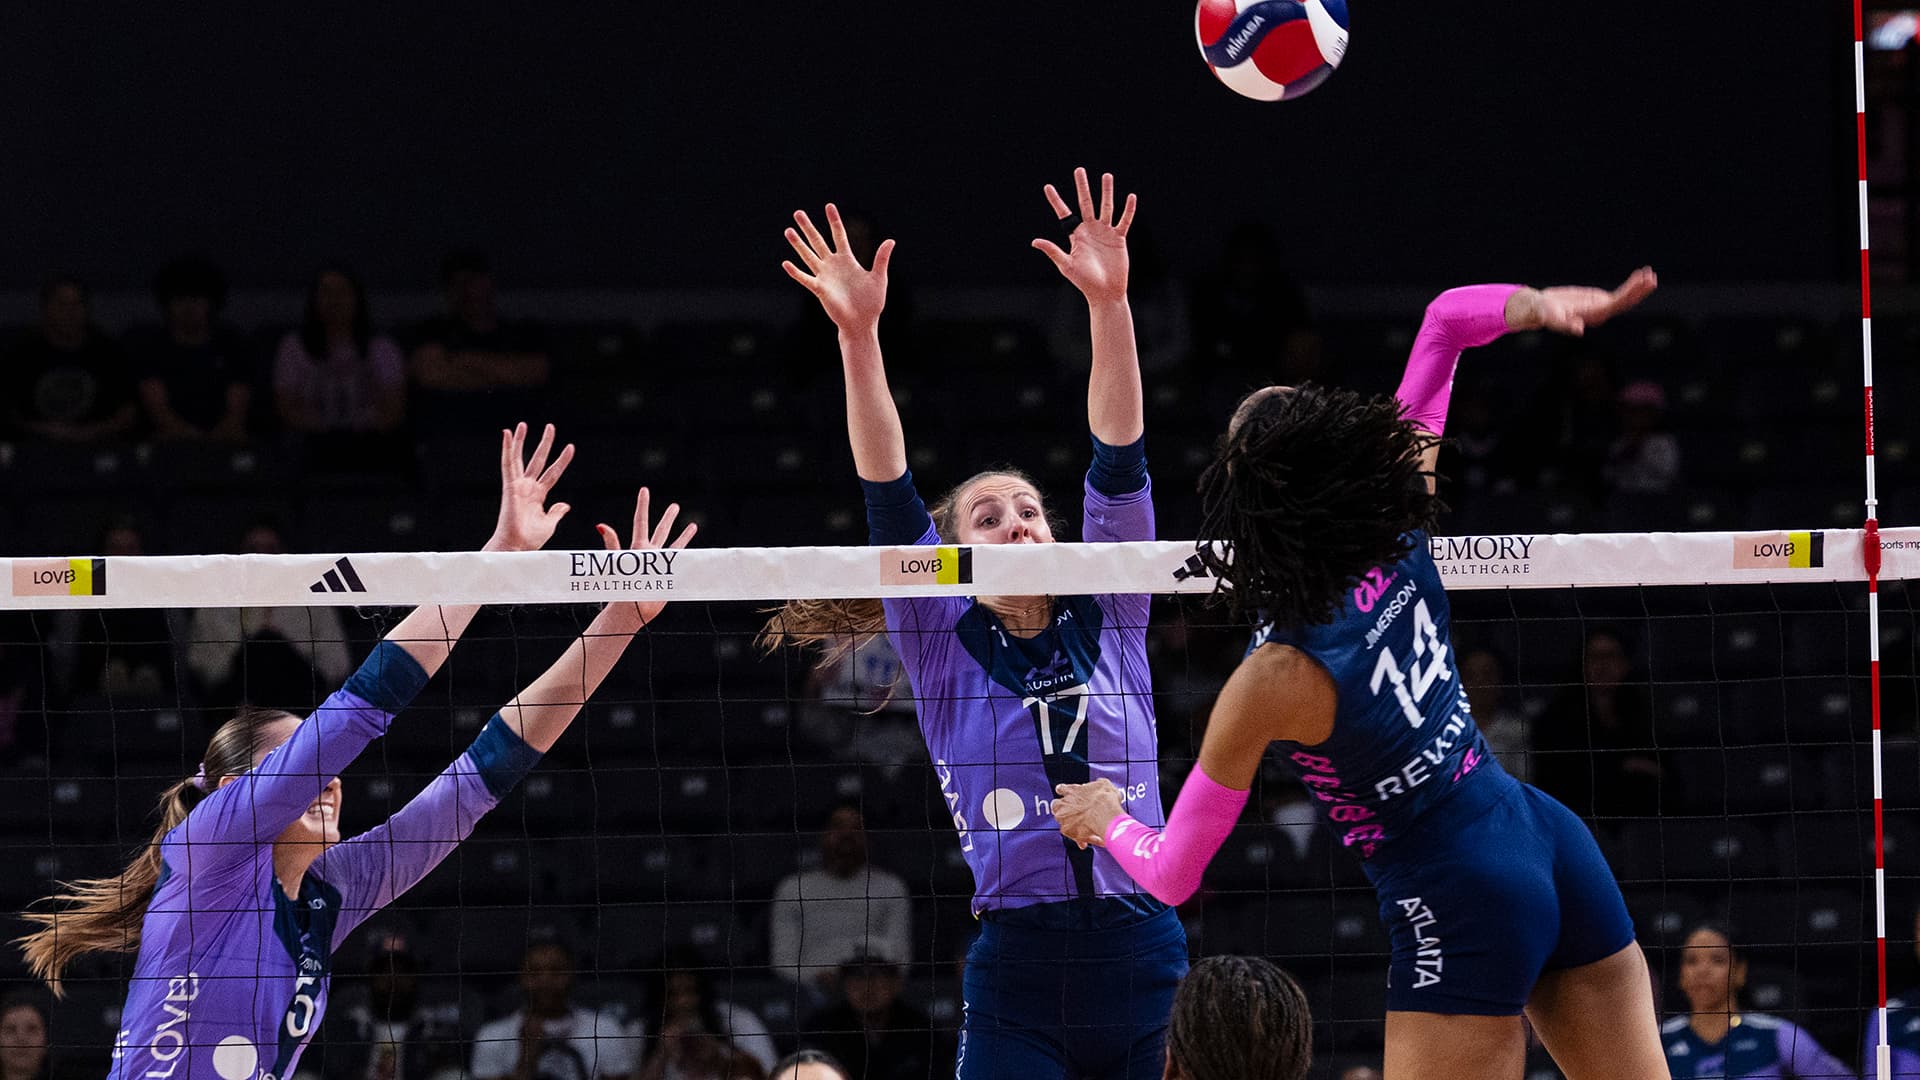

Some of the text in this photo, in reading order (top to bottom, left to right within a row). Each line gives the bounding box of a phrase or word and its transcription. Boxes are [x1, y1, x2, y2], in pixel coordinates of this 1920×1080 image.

[1226, 15, 1266, 60] MIKASA
[1430, 536, 1535, 561] EMORY
[1880, 541, 1904, 550] ports
[569, 551, 679, 577] EMORY
[1441, 563, 1530, 575] EALTHCARE
[571, 580, 674, 592] HEALTHCARE
[1369, 597, 1453, 728] 14
[1022, 683, 1090, 756] 17
[145, 972, 200, 1079] LOVB
